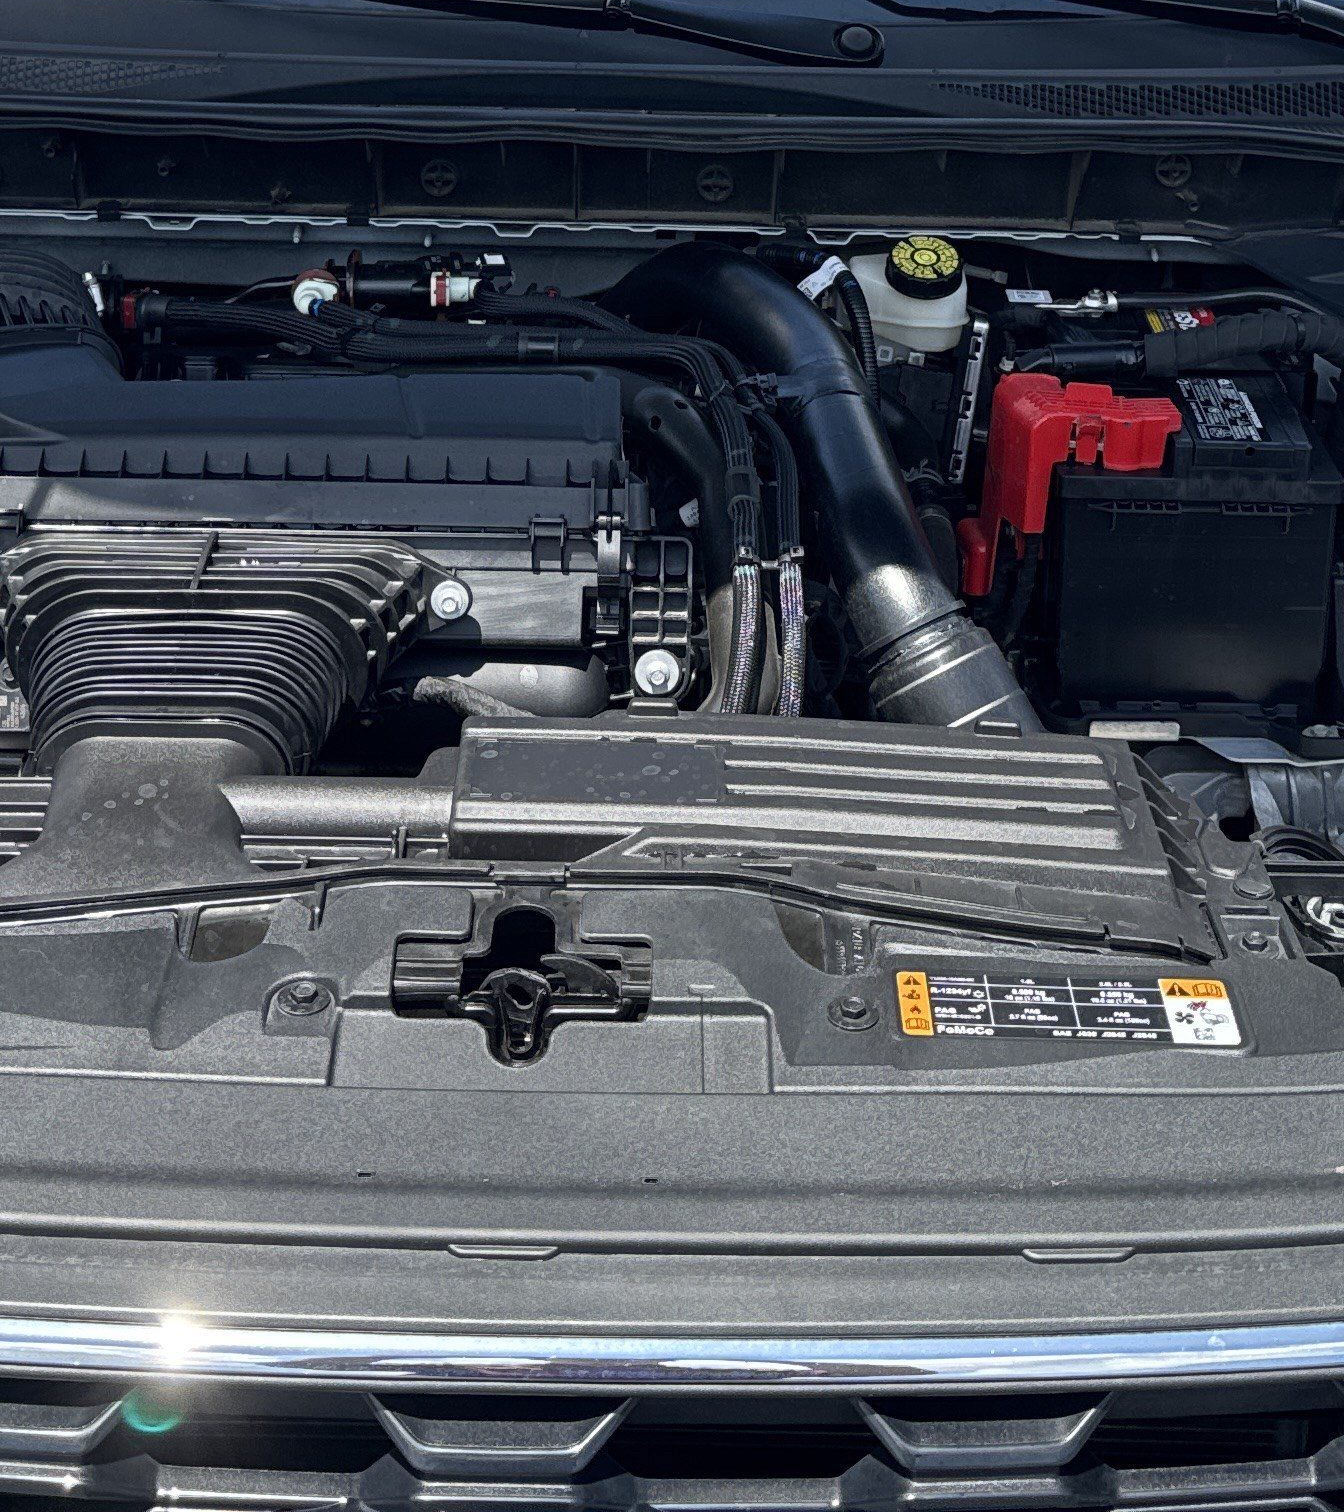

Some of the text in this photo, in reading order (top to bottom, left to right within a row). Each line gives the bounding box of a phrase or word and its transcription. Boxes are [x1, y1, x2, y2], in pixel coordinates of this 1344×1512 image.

[930, 986, 972, 996] R-1234yf
[934, 1006, 957, 1014] PAG
[937, 1025, 995, 1036] FoMoCo
[1052, 1029, 1073, 1037] SAE
